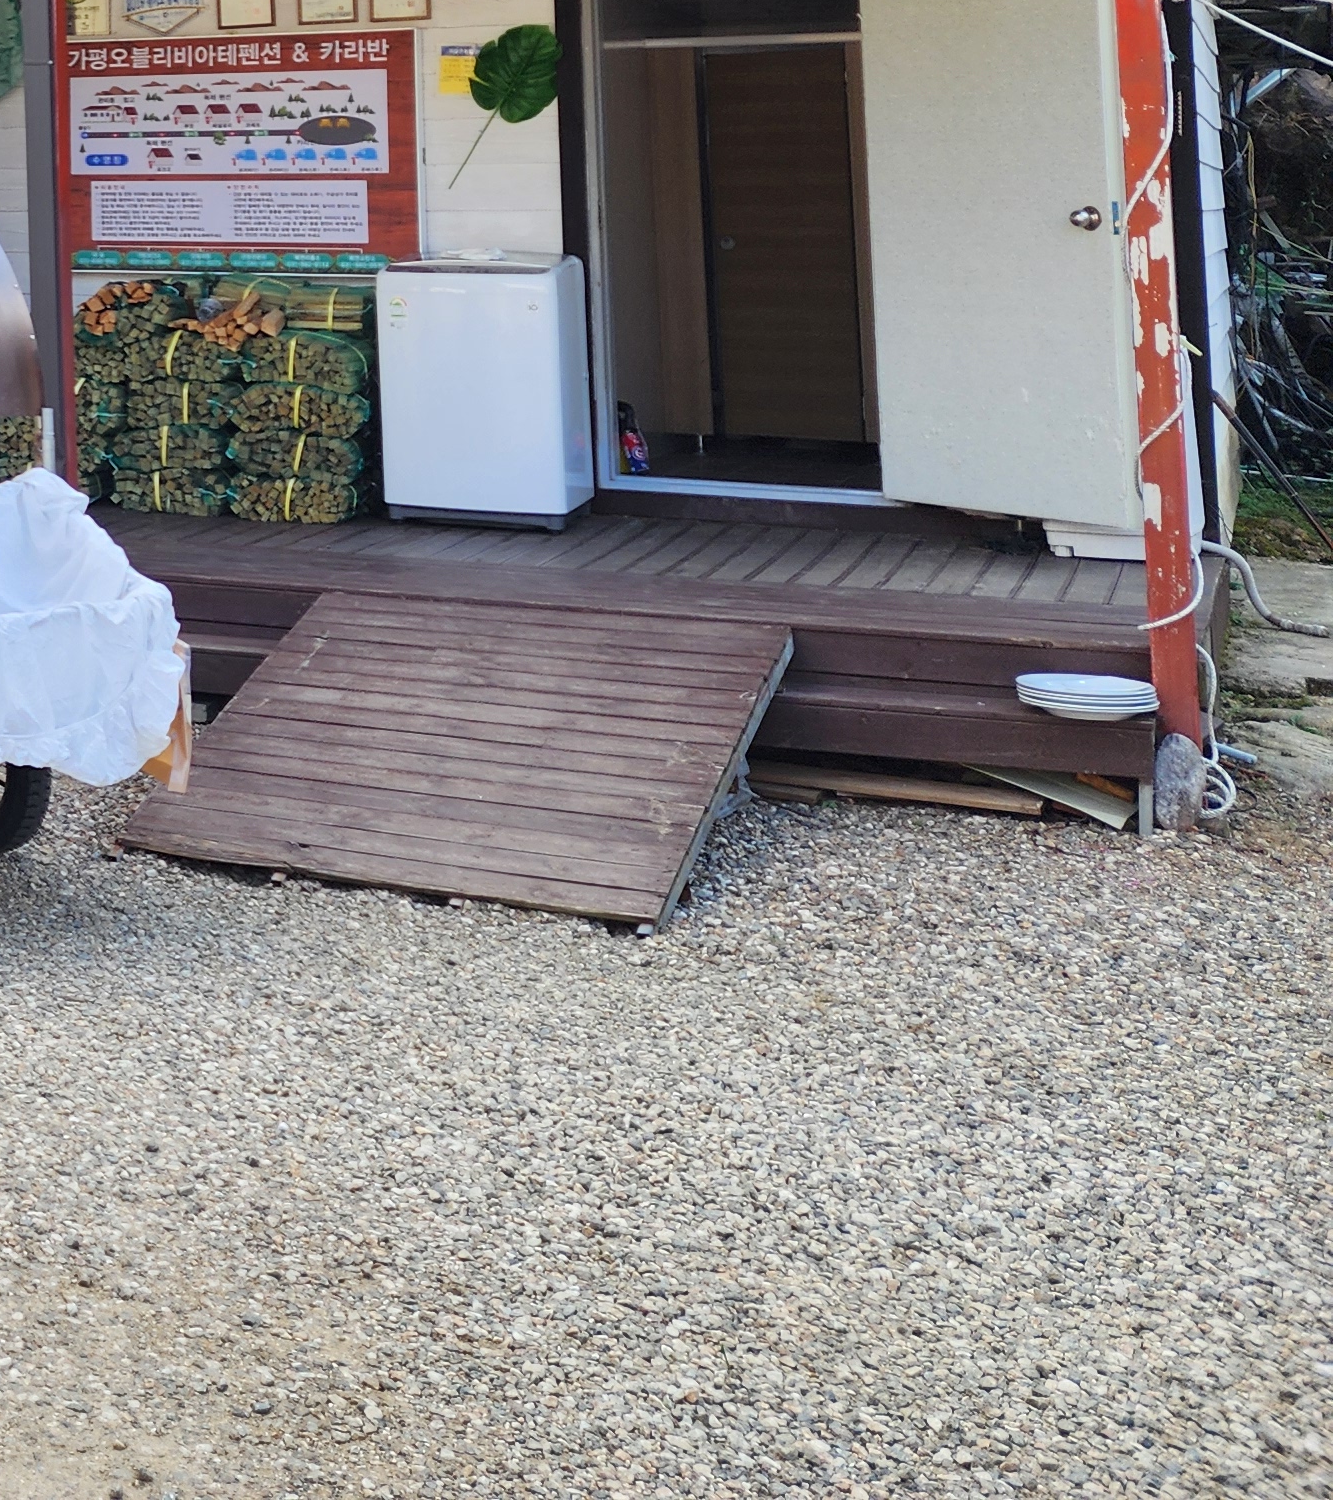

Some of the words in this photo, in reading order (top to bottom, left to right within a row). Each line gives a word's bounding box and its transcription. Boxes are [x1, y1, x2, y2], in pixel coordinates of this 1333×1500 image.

[67, 42, 281, 71] 가평오블리비아테펜션
[292, 42, 310, 63] &
[320, 39, 390, 64] 카라반
